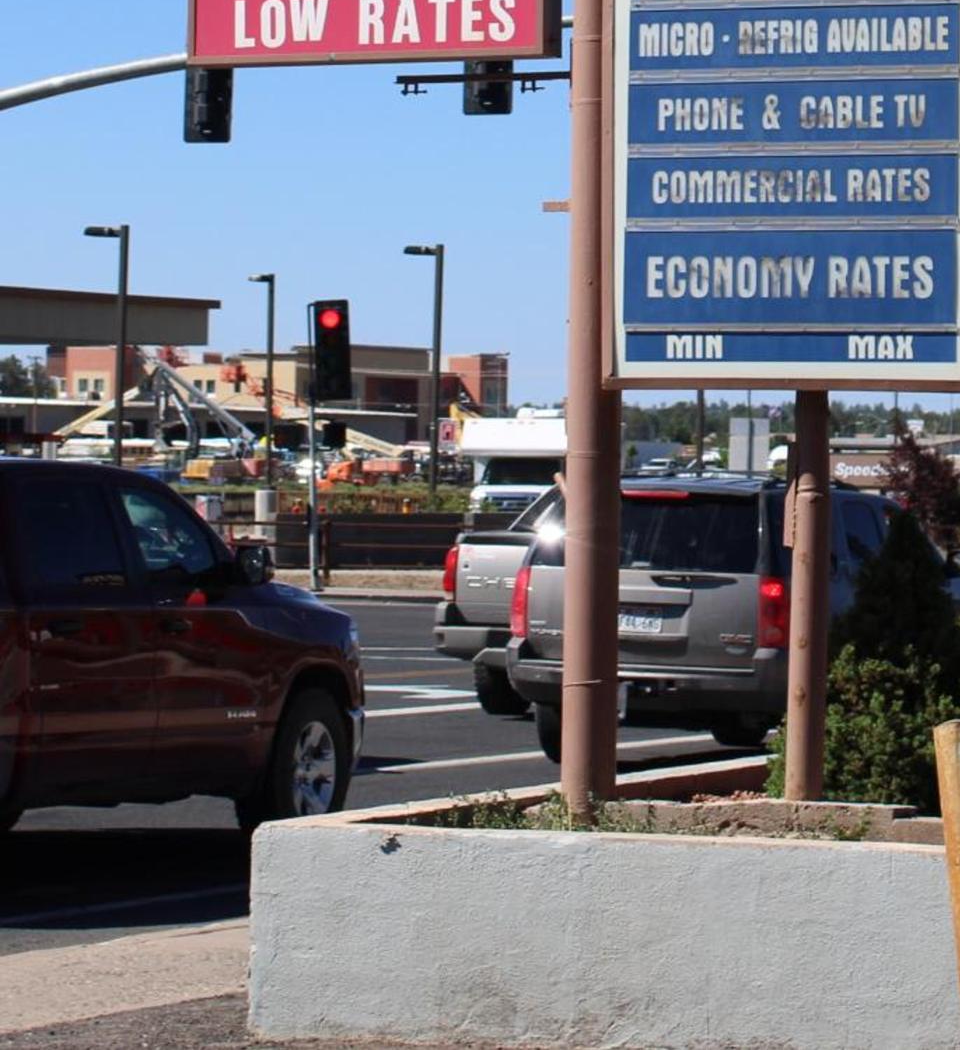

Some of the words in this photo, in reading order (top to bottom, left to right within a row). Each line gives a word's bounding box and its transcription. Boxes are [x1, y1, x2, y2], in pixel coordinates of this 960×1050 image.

[638, 21, 715, 57] MICRO
[738, 18, 818, 55] REFRIG
[827, 16, 949, 53] AVAILABLE
[657, 97, 744, 131] PHONE
[762, 94, 781, 130] &
[800, 95, 884, 129] CABLE
[895, 94, 926, 128] TV
[652, 169, 837, 204] COMMERCIAL
[847, 167, 931, 202] RATES
[646, 255, 815, 299] ECONOMY
[828, 254, 934, 299] RATES
[666, 334, 723, 359] MIN
[848, 334, 914, 359] MAX
